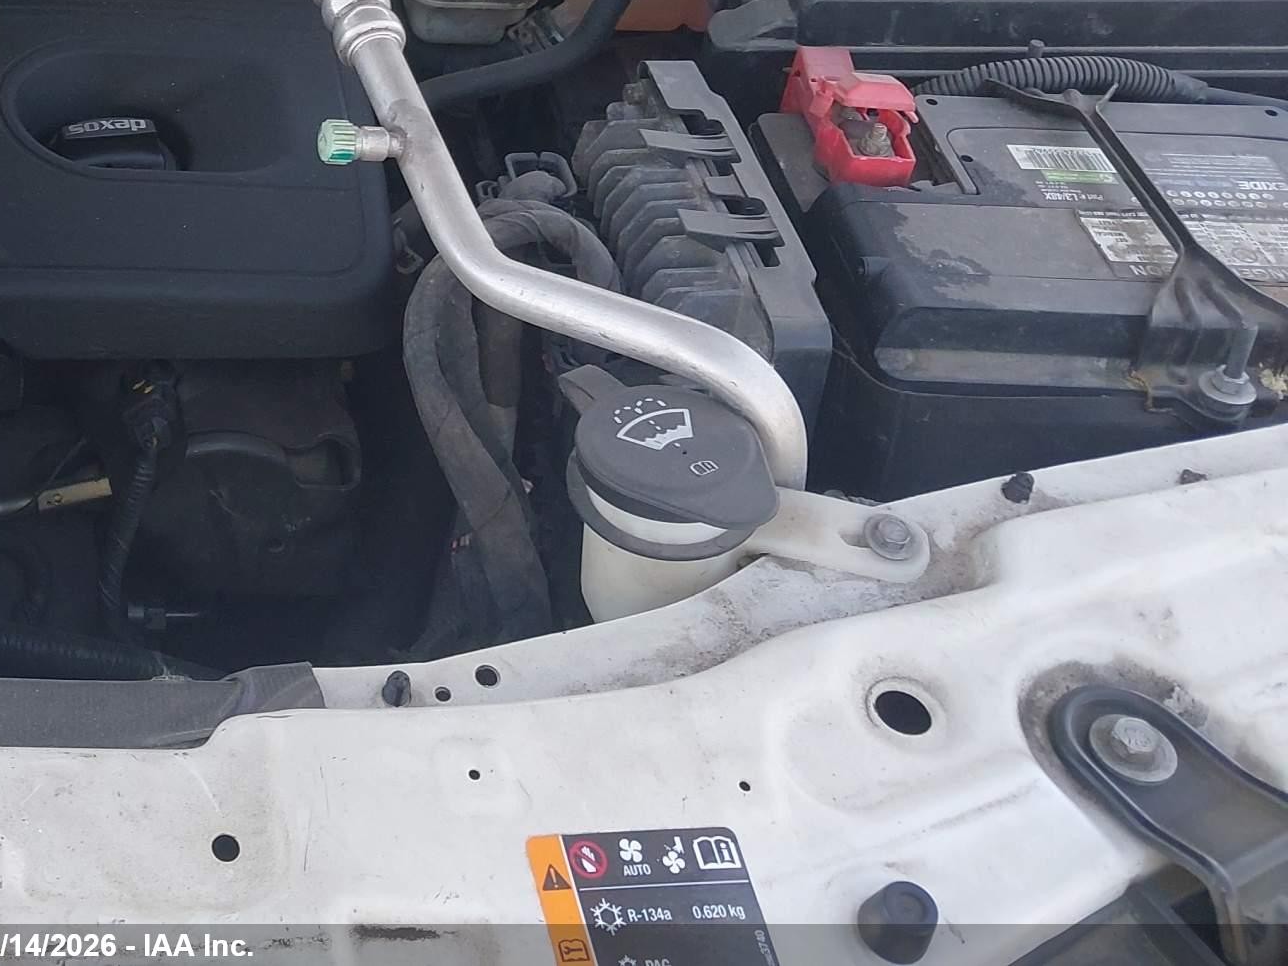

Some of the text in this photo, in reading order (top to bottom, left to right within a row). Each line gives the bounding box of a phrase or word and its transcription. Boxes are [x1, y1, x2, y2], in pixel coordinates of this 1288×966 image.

[68, 118, 147, 135] dexos
[1238, 180, 1288, 191] EXIDE
[623, 864, 652, 877] AUTO
[627, 907, 673, 923] R-134a
[692, 903, 746, 921] 0.620 kg
